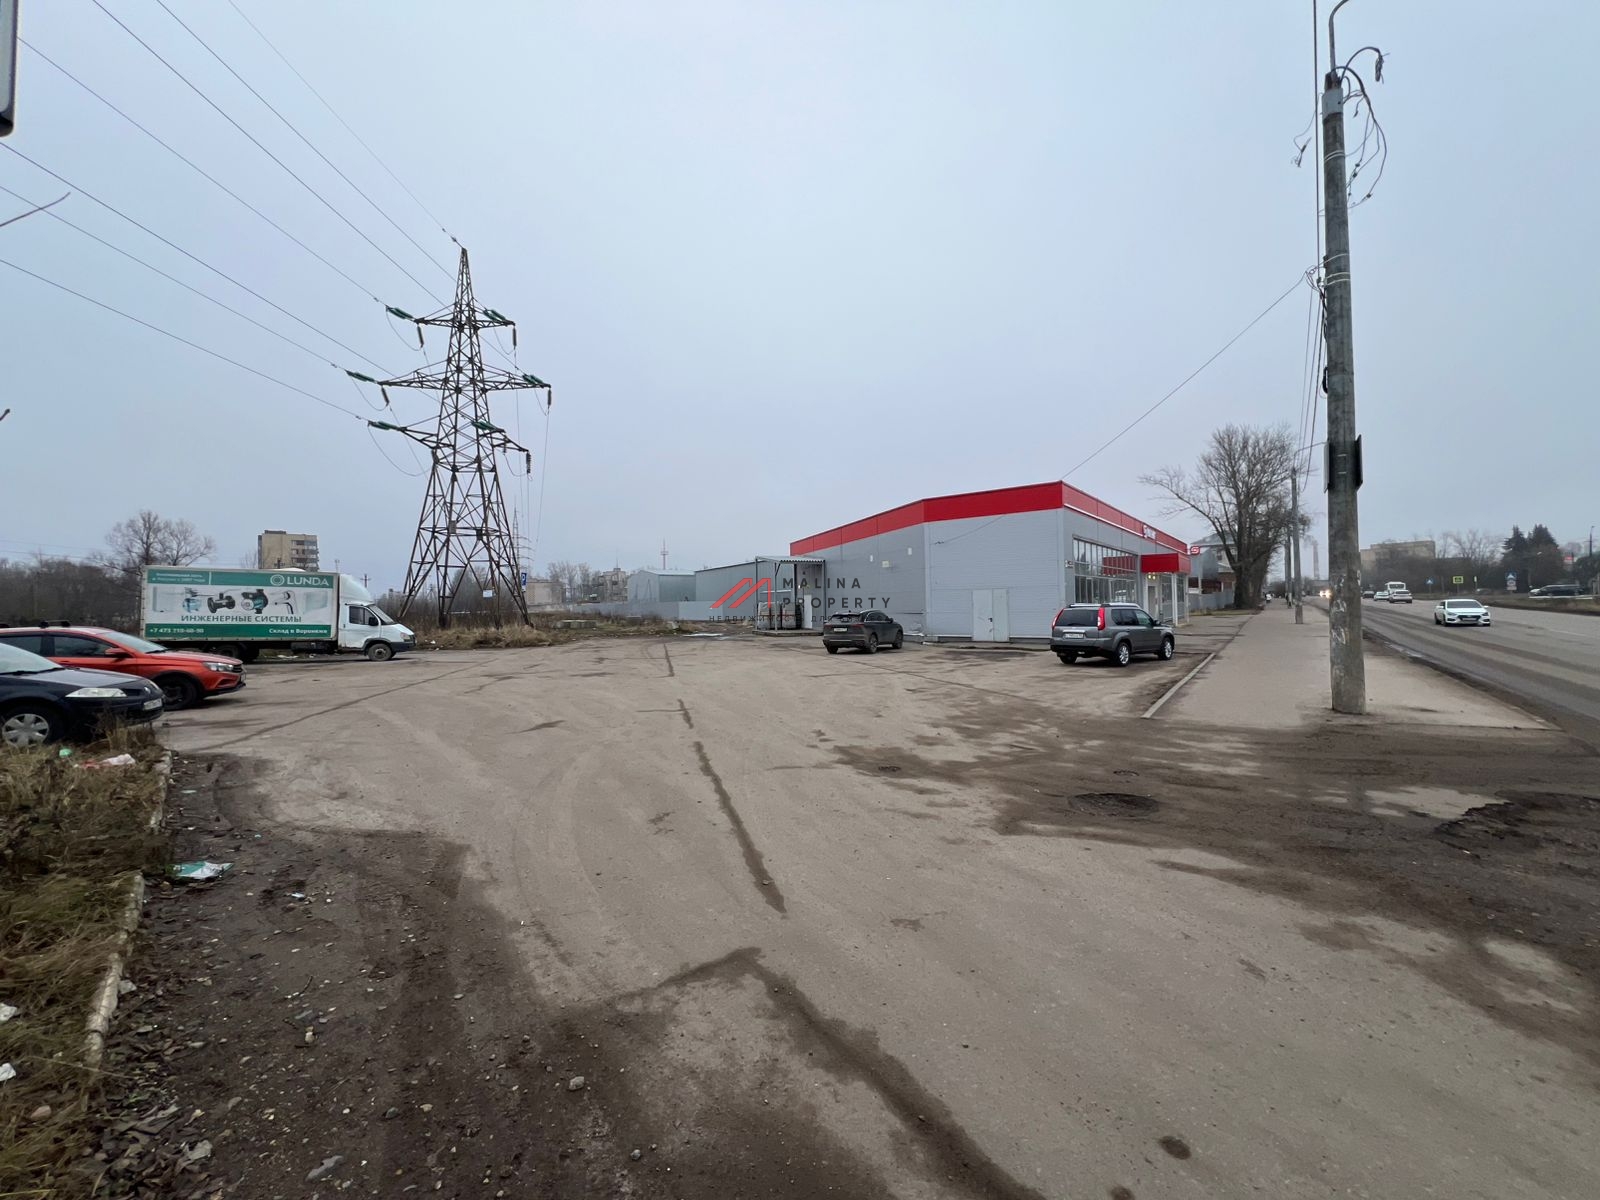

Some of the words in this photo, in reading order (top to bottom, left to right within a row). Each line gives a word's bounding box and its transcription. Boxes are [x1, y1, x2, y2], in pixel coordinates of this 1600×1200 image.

[287, 576, 329, 586] LUNDA
[181, 615, 252, 623] ИНЖЕНЕРНЫЕ
[255, 615, 302, 623] СИСТЕМЫ
